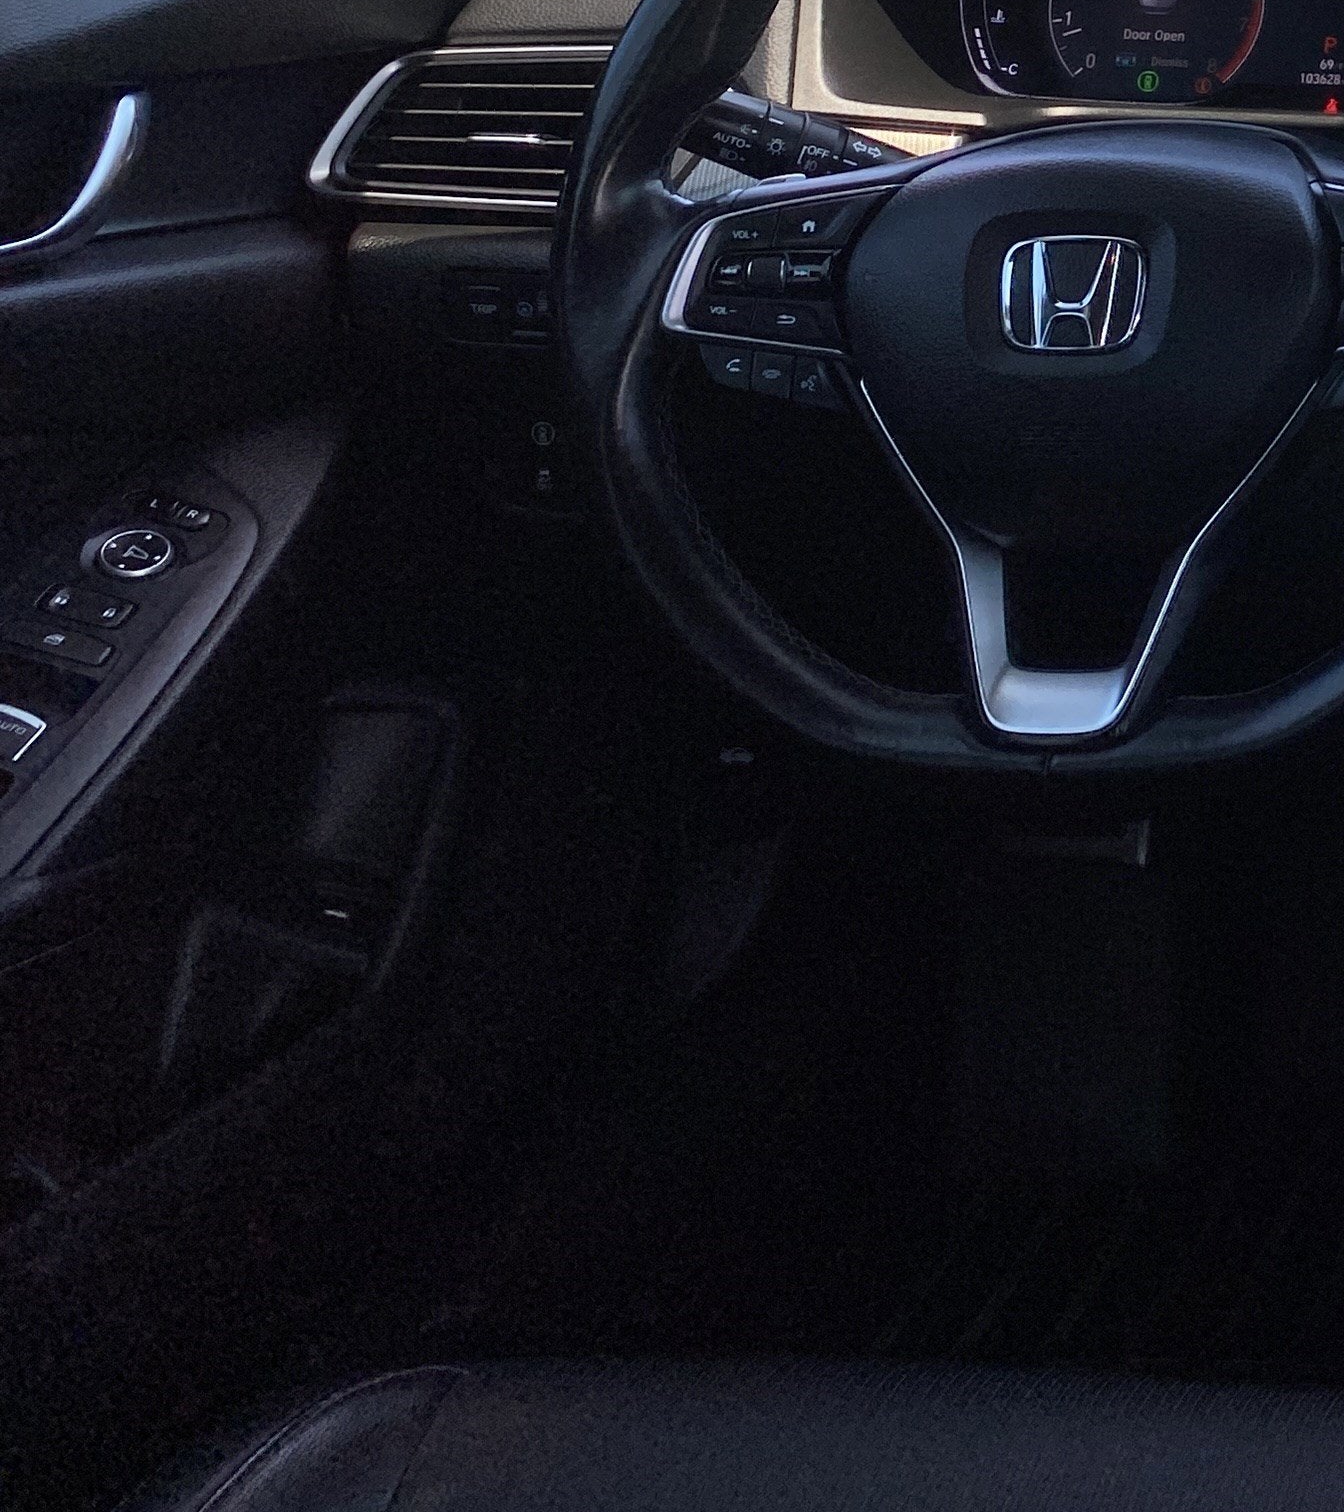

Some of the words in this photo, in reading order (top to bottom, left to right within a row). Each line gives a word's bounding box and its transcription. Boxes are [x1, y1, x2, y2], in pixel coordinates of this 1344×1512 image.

[1064, 10, 1073, 25] 1
[1124, 28, 1152, 42] Door
[1154, 29, 1186, 43] Open
[1323, 36, 1338, 54] P
[1085, 53, 1096, 69] 0
[1151, 56, 1189, 69] Dismiss
[1320, 59, 1335, 70] 69
[1008, 64, 1019, 76] C
[1300, 73, 1341, 86] 103628
[712, 131, 746, 149] AUTO
[808, 145, 831, 159] OFF
[149, 498, 159, 509] L
[185, 508, 200, 519] R
